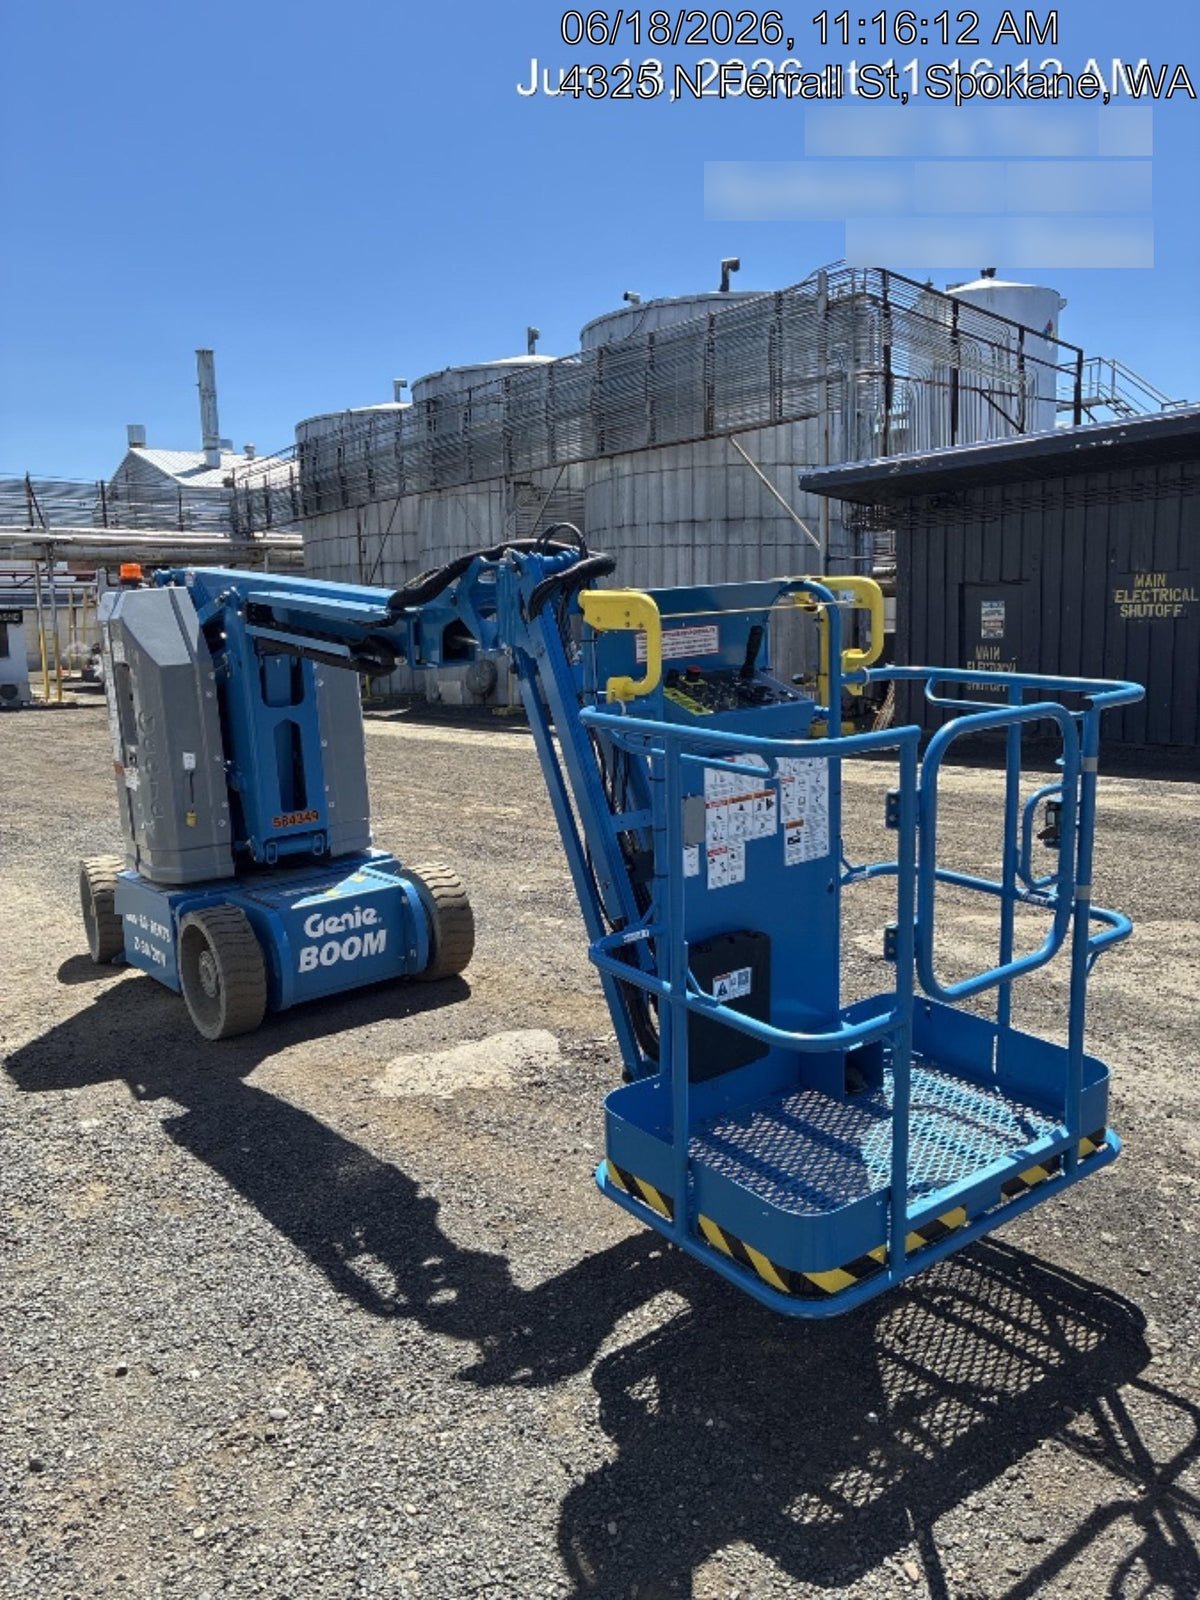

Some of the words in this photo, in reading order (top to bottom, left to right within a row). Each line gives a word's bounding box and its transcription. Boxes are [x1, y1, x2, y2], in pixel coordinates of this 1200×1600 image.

[1134, 573, 1167, 588] MAIN
[1114, 587, 1199, 603] ELECTRICAL
[1120, 603, 1183, 618] SHUTOFF
[303, 905, 378, 938] Genie
[298, 929, 387, 974] BOOM
